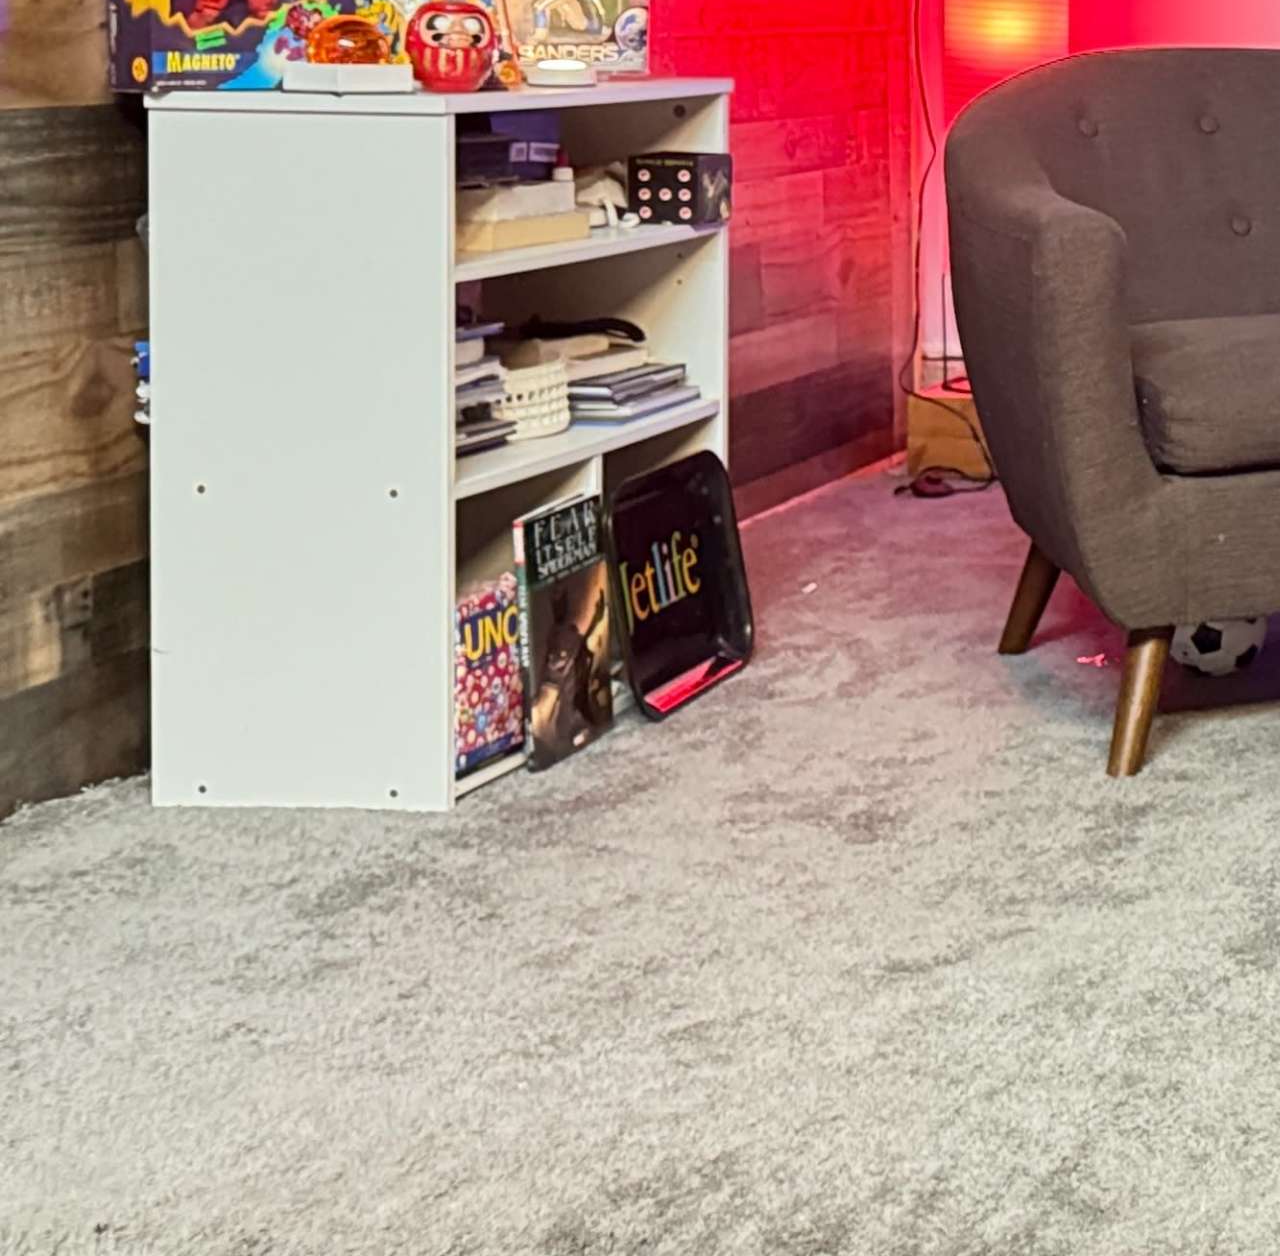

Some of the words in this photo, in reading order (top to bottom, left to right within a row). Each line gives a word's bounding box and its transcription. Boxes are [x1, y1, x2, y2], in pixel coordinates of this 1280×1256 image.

[166, 50, 237, 73] MAGNETO
[518, 44, 623, 61] SANDERS
[533, 500, 597, 549] FEAR
[618, 530, 701, 637] Jetlife
[463, 605, 519, 662] UNO
